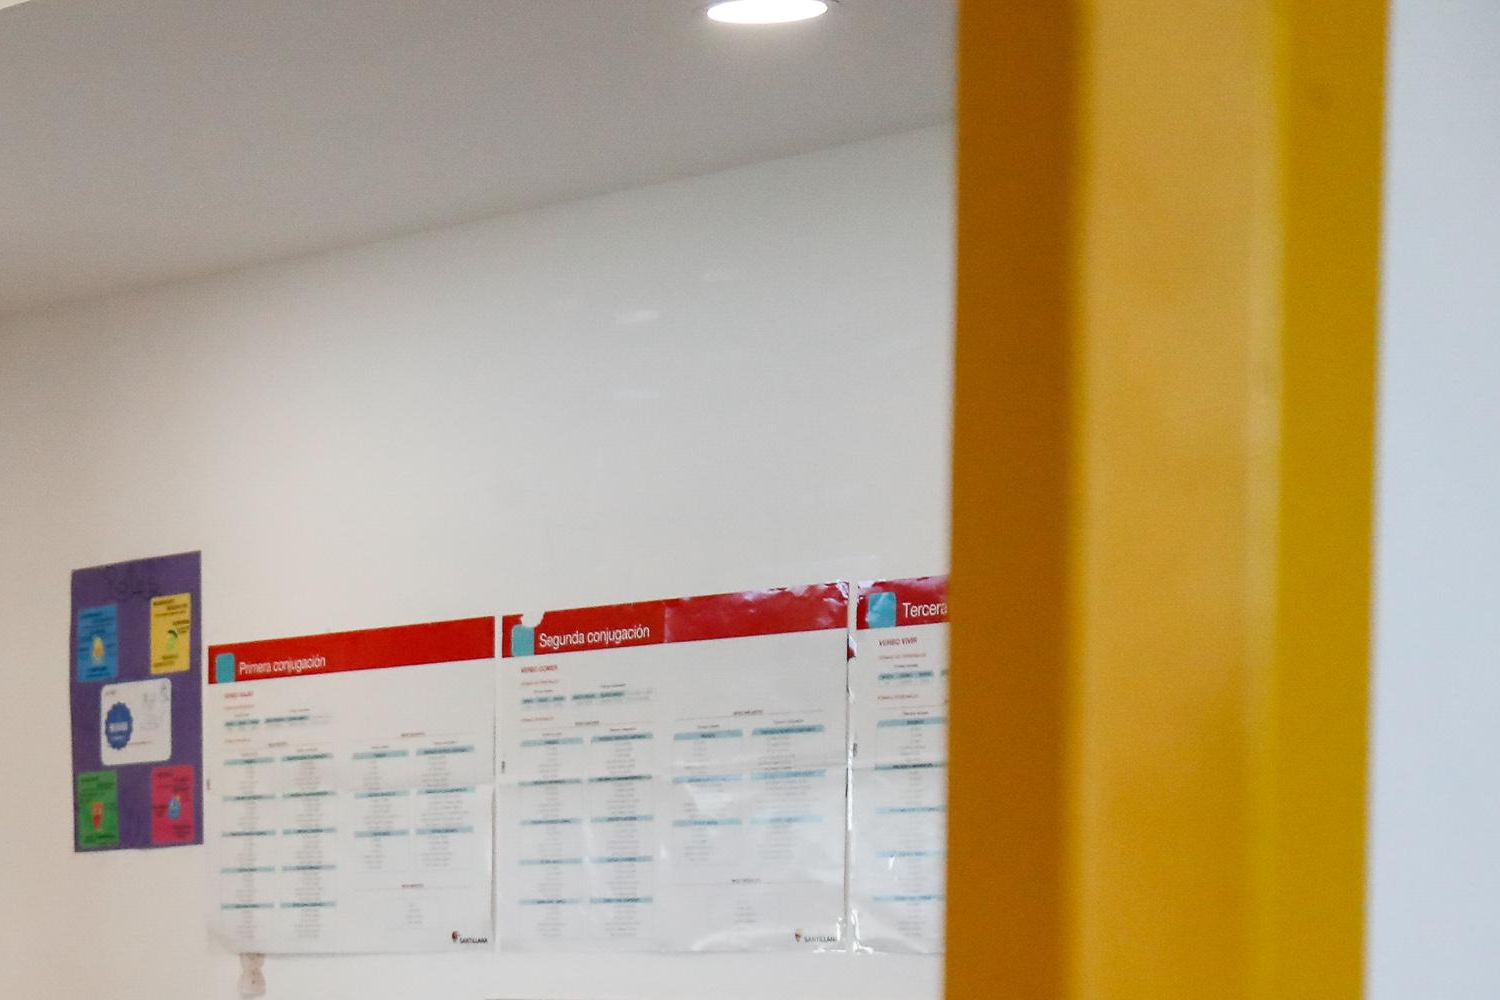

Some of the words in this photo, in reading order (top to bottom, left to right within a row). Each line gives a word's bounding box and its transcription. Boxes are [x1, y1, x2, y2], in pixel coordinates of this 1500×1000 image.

[539, 630, 585, 650] Segunda
[587, 625, 650, 643] conjugación
[239, 661, 272, 675] Primera
[273, 655, 326, 672] conjugación
